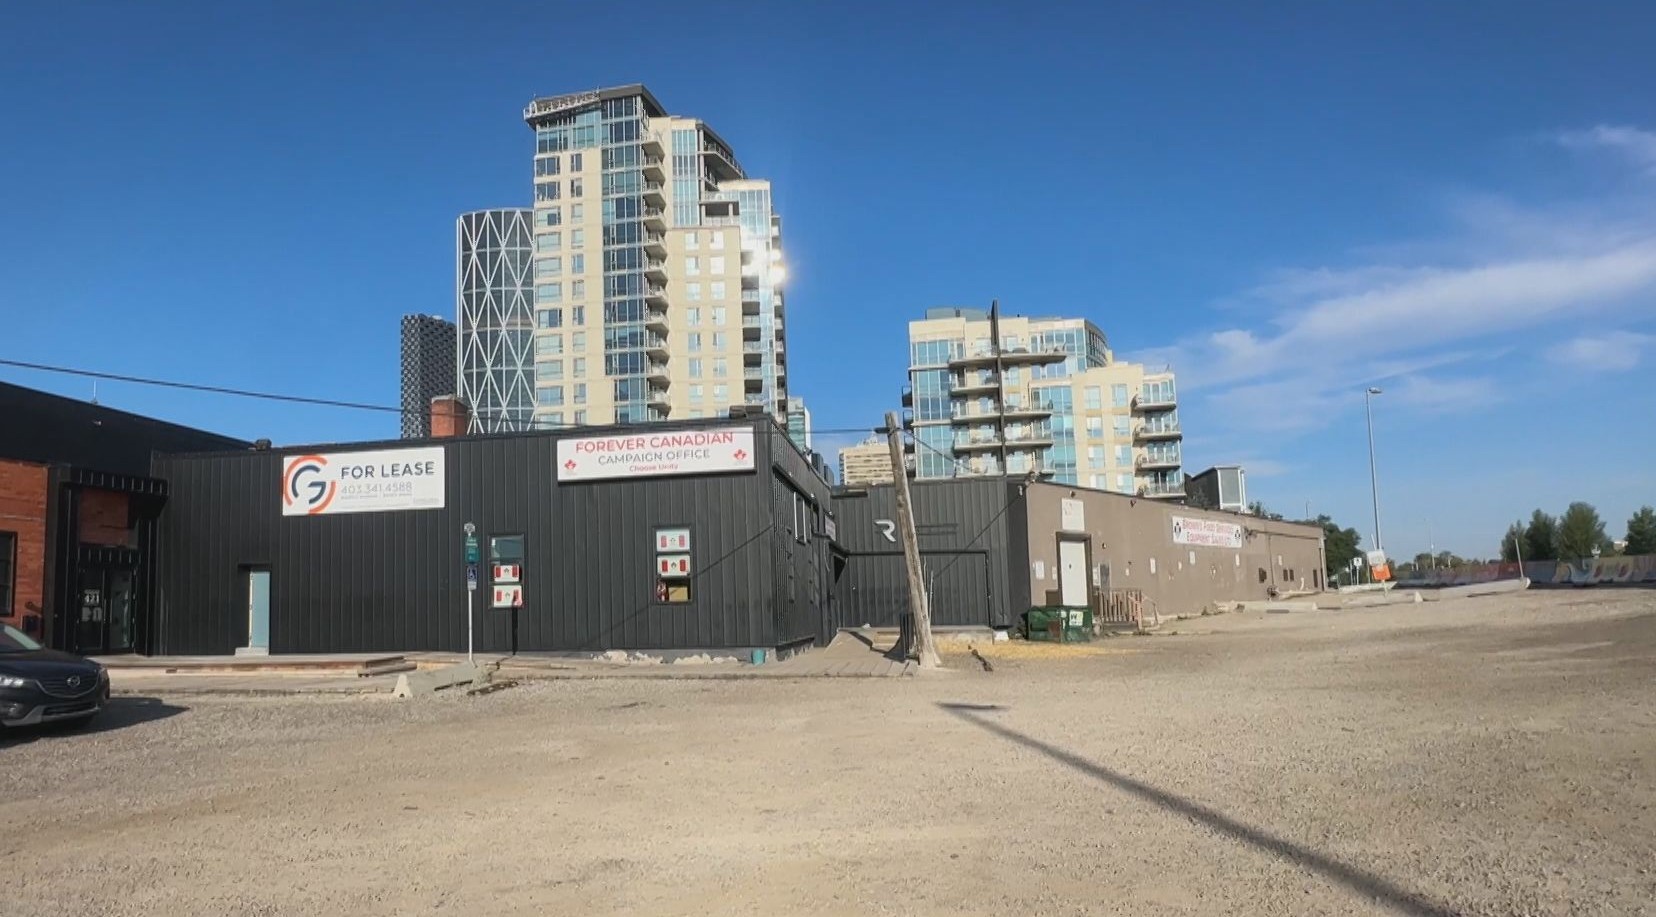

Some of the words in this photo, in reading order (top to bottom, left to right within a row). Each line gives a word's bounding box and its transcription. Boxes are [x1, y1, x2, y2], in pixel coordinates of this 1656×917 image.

[576, 438, 645, 453] FOREVER
[649, 432, 733, 449] CANADIAN
[598, 451, 664, 465] CAMPAIGN
[666, 449, 711, 460] OFFICE
[341, 465, 375, 479] FOR
[381, 461, 435, 478] LEASE
[629, 464, 657, 472] Choose
